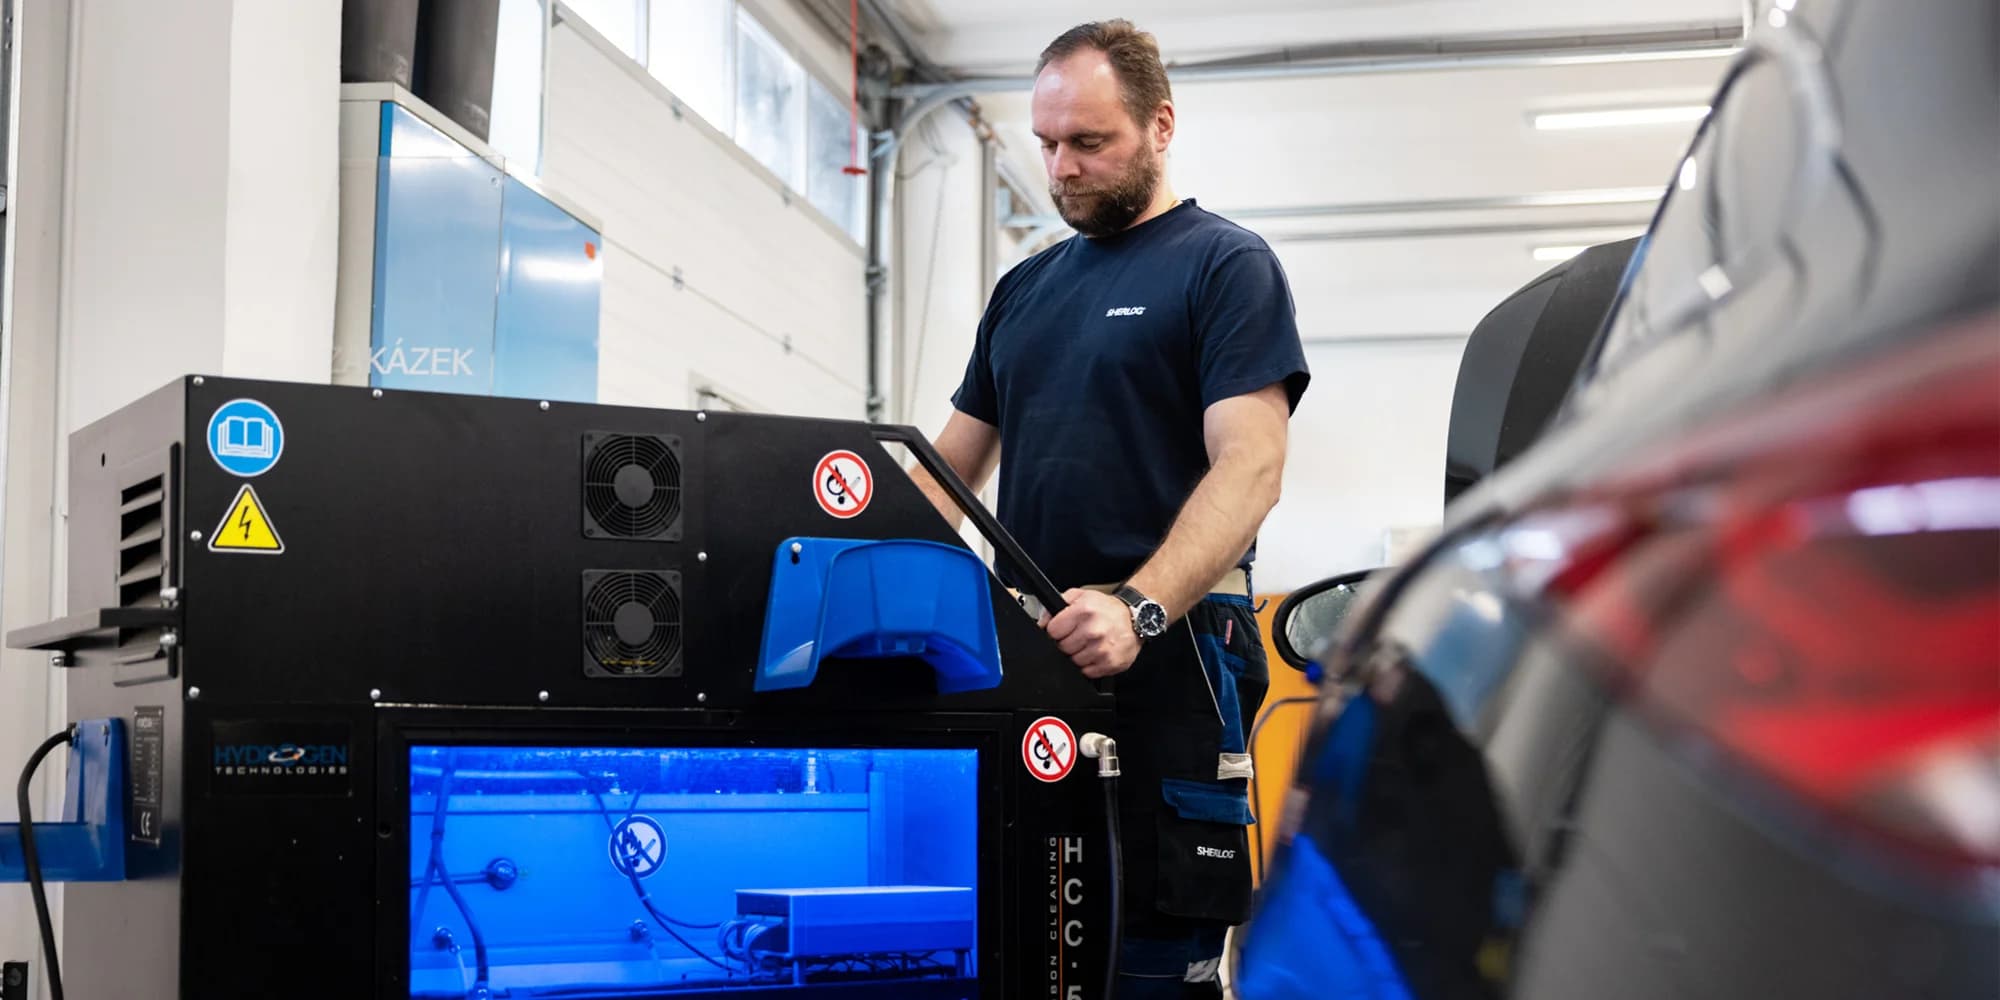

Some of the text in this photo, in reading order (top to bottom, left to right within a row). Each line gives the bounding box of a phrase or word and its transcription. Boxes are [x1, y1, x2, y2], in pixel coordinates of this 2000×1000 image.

[1105, 306, 1147, 317] SHERLOG
[214, 743, 348, 767] HYDROGEN
[214, 766, 348, 775] TECHNOLOGIES
[1196, 846, 1236, 859] SHERLOG
[1049, 836, 1058, 1000] BON CLEANING
